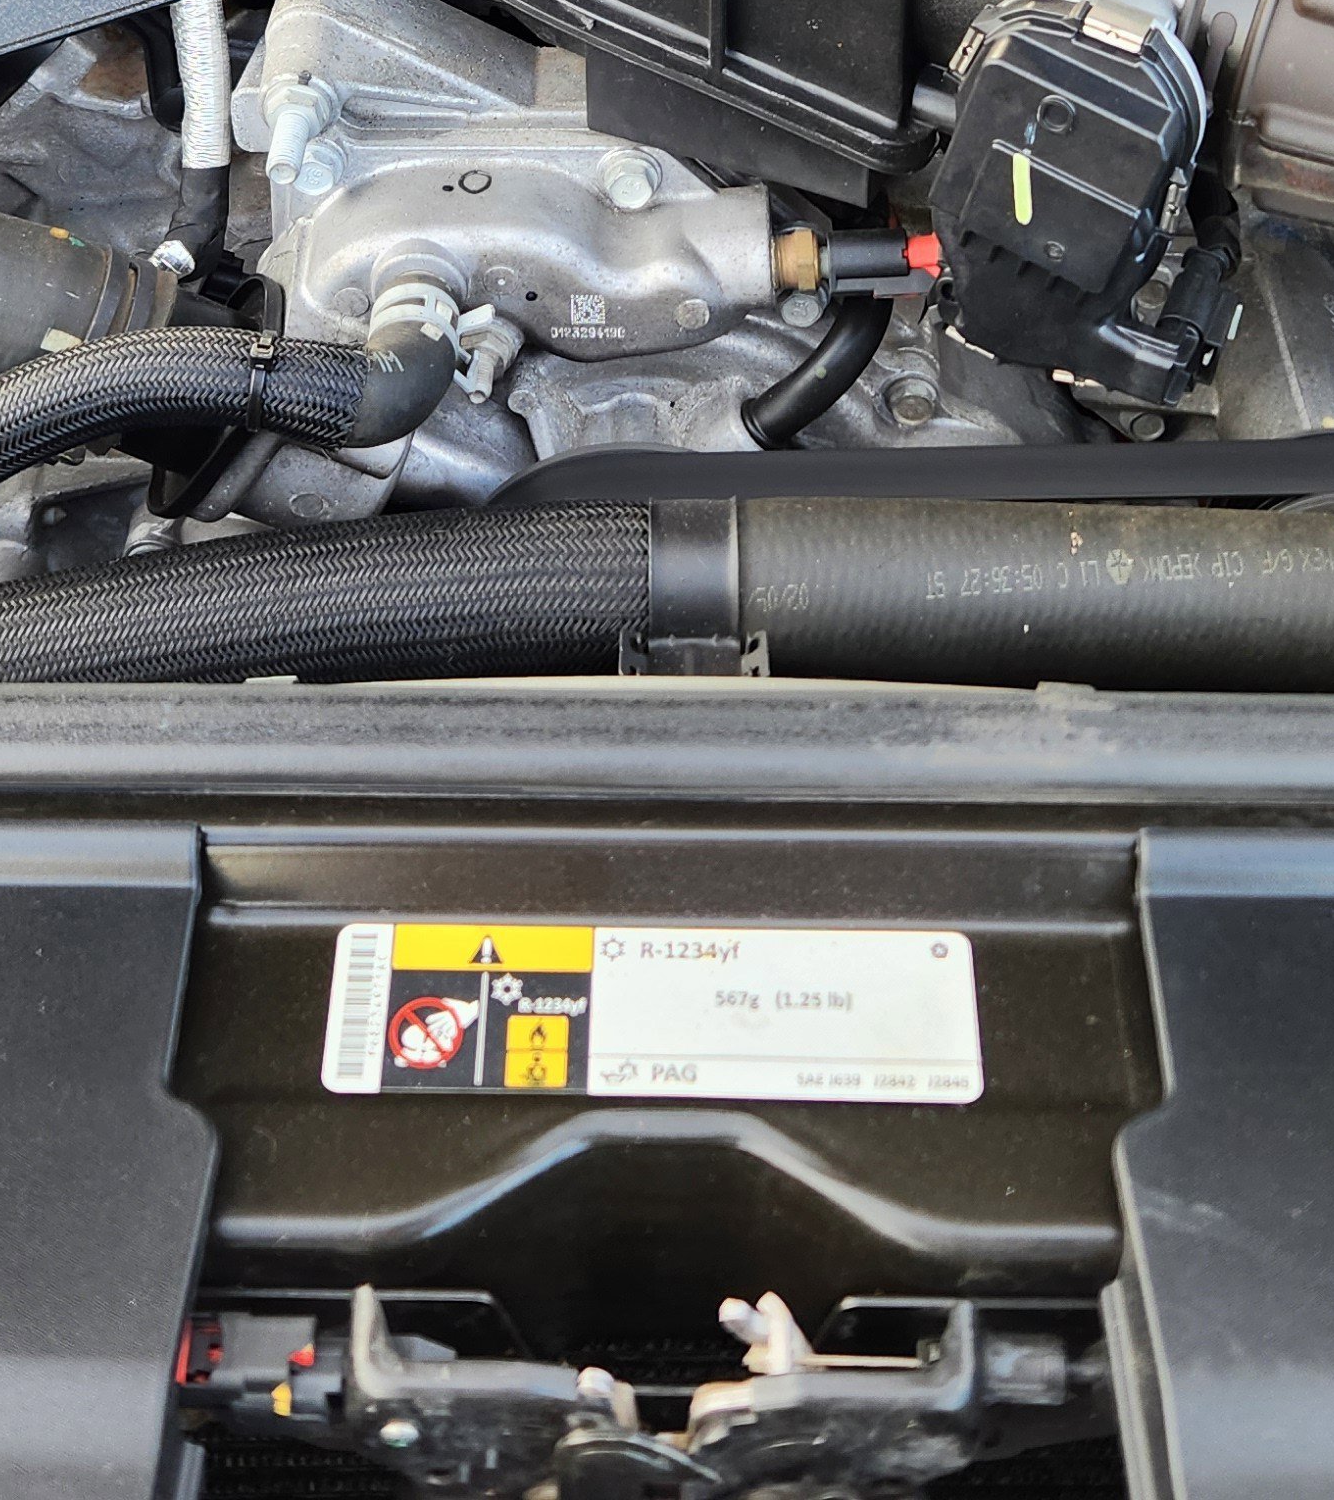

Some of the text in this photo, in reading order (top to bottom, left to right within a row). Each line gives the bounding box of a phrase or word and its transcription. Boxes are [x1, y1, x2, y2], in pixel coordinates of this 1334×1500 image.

[639, 940, 741, 963] R-1234yf
[517, 995, 588, 1018] R-1234yf
[715, 990, 854, 1011] 567g (1.25 lb)
[651, 1063, 697, 1084] PAG
